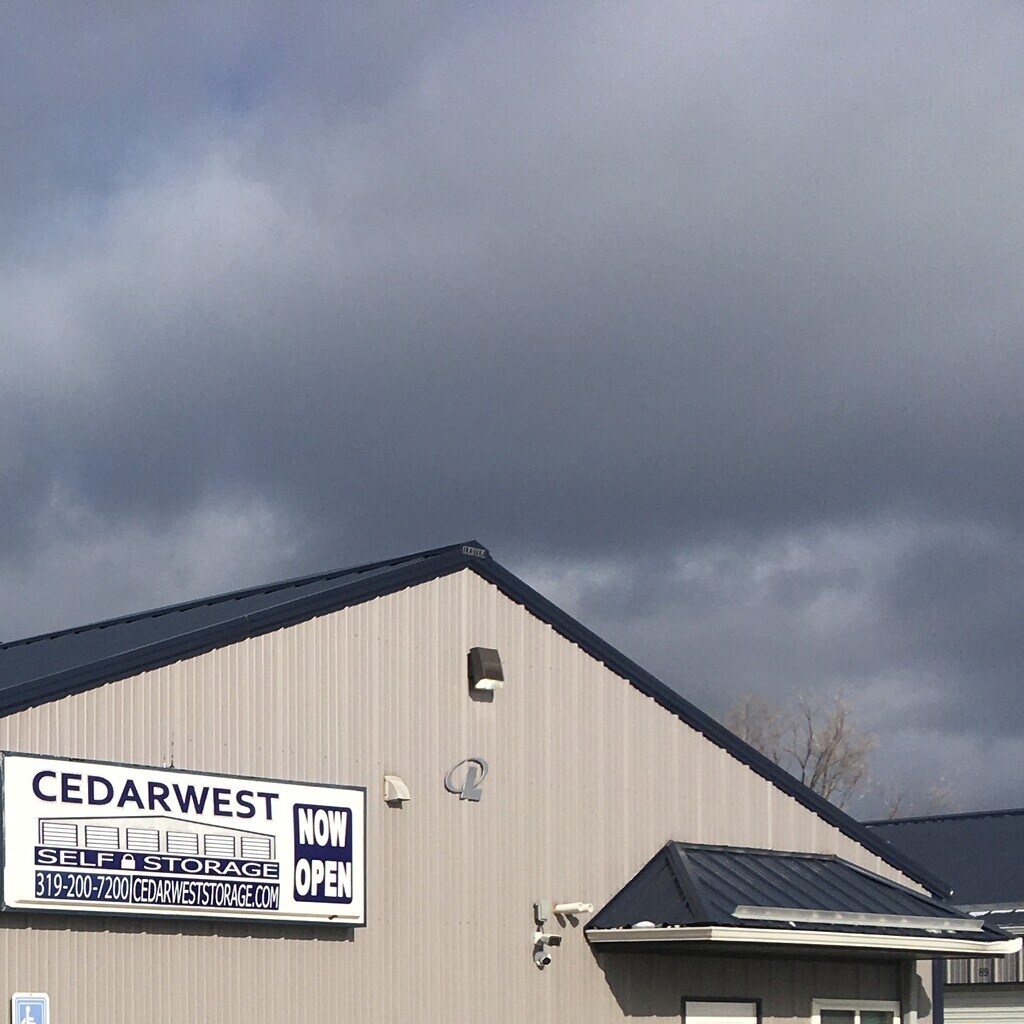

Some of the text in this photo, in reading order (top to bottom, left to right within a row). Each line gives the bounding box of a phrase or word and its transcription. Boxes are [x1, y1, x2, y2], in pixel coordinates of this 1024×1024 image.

[32, 770, 279, 821] CEDARWEST
[298, 808, 348, 848] NOW
[36, 849, 279, 878] SELF STORAGE
[294, 858, 351, 898] OPEN
[35, 872, 280, 909] 319-200-7200 CEDARWESTSTORAGE.COM
